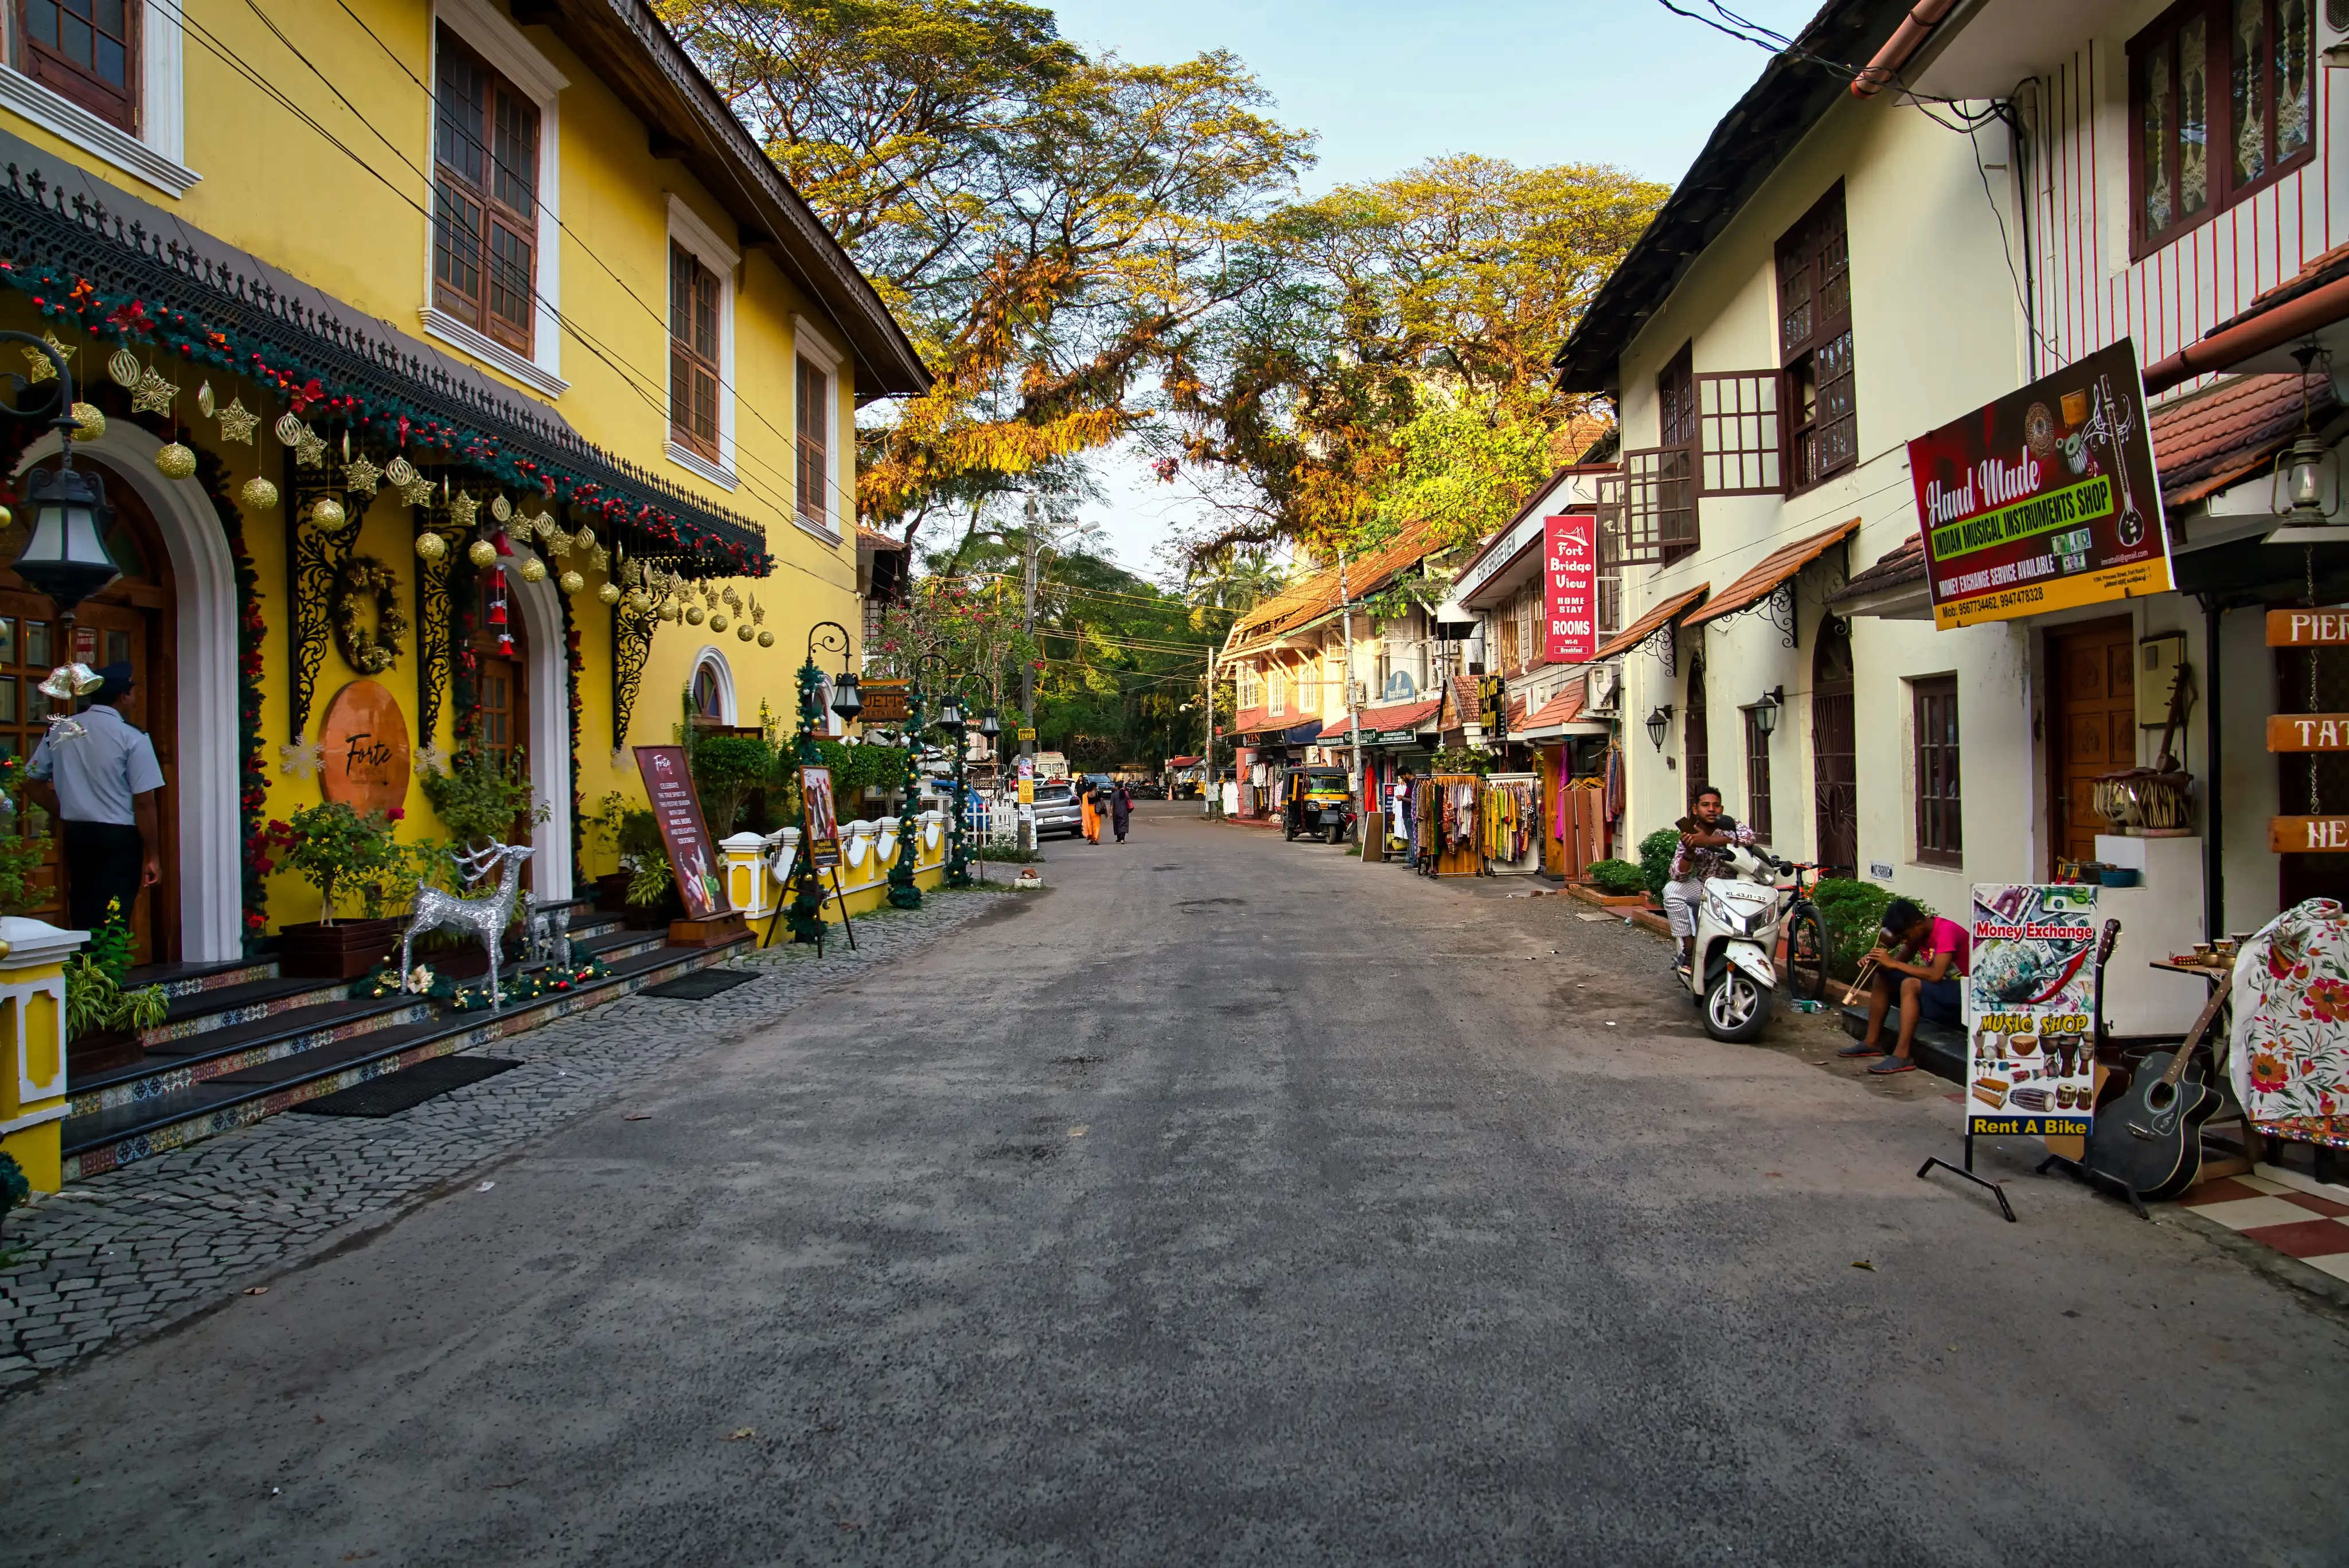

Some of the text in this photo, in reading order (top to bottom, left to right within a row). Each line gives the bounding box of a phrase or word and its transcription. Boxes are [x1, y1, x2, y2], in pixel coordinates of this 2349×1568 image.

[1926, 445, 2040, 528] Hand Made
[1933, 481, 2108, 557] INDIAN MUSICAL INSTRUMENTS SHOP
[1557, 541, 1585, 556] Fort
[1550, 557, 1592, 573] Bridge
[1555, 574, 1586, 589] View
[1938, 553, 2055, 598] MONEY EXCHANGE SERVICE AVAILABLE
[1557, 597, 1585, 605] HOME
[1942, 586, 2043, 619] Mob: 9567734462, 9947478328
[1552, 620, 1590, 635] ROOMS
[864, 694, 907, 707] JETTY
[1247, 733, 1261, 743] ZEN
[345, 733, 393, 777] Forte
[653, 754, 671, 772] Forte
[1874, 864, 1889, 879] NO PARKING
[1976, 921, 2094, 941] Money Exchange
[1979, 1012, 2088, 1036] MUSIC SHOP
[1974, 1118, 2087, 1134] Rent A Bike
